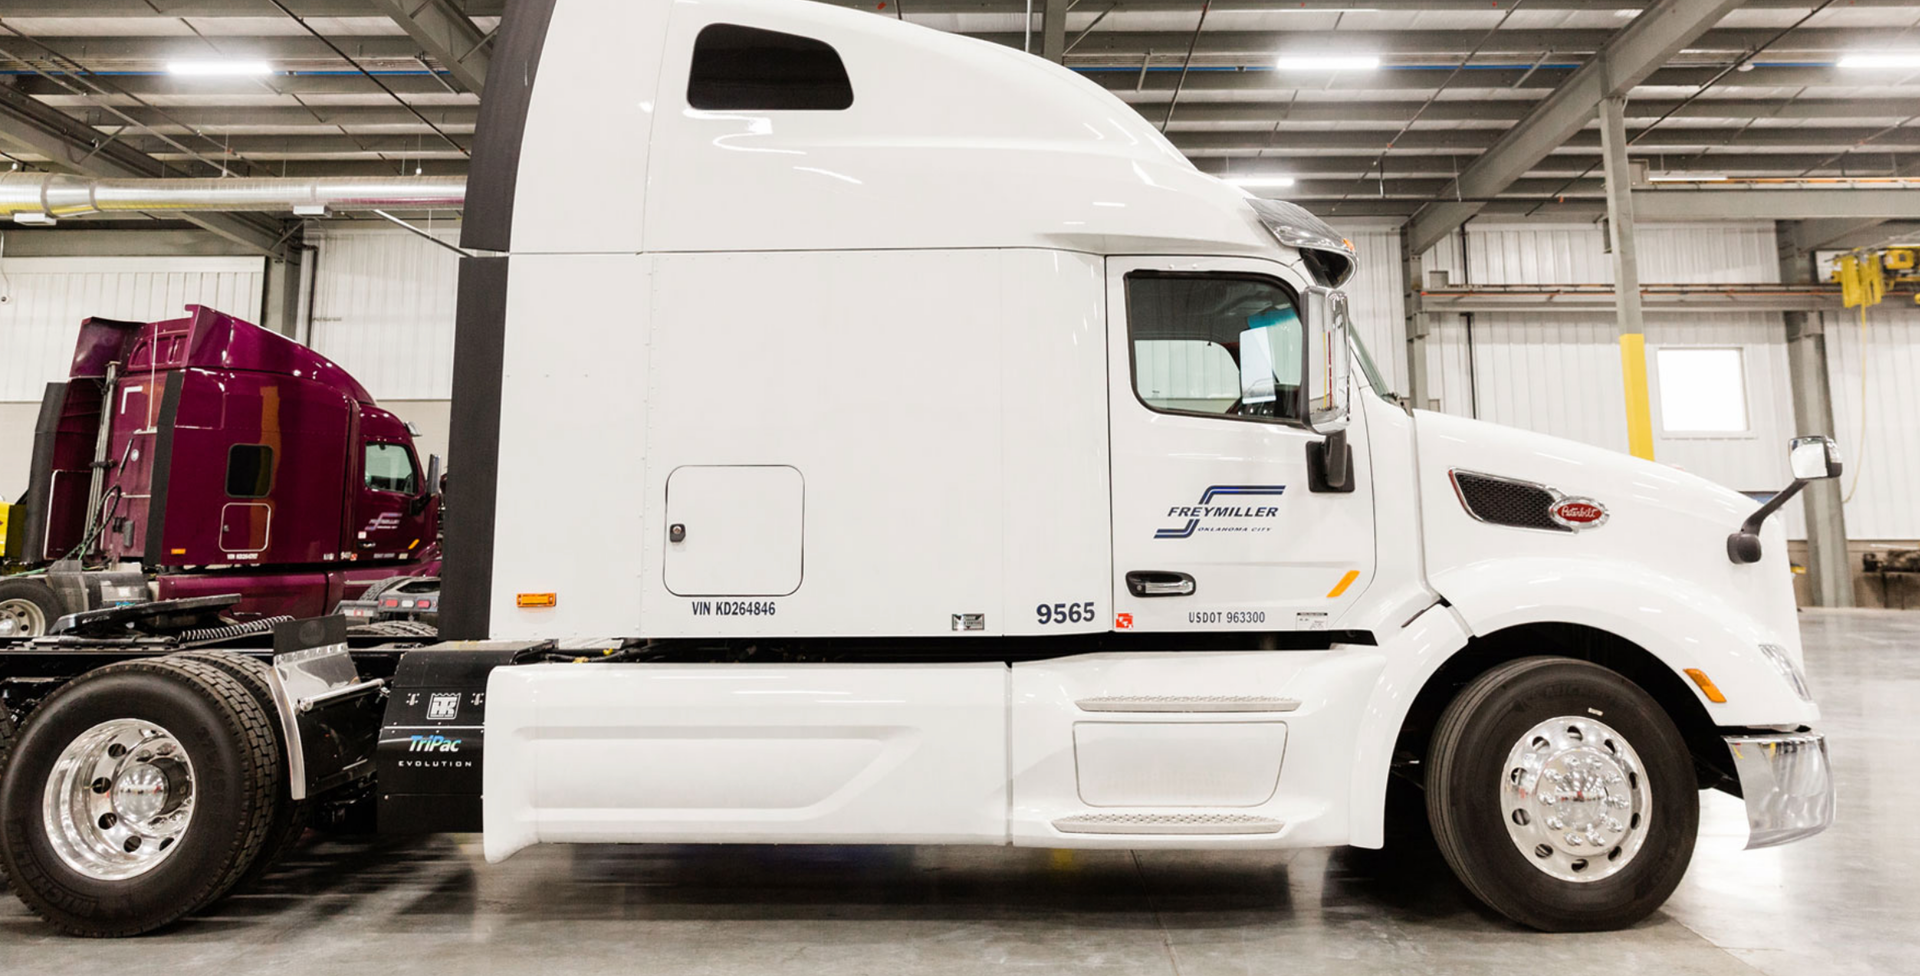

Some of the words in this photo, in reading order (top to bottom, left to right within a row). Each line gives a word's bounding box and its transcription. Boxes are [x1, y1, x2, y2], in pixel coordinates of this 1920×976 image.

[1168, 507, 1278, 517] FREYMILLER
[692, 601, 711, 616] VIN
[715, 601, 776, 616] KD264846
[1036, 602, 1096, 625] 9565
[1188, 611, 1223, 624] USDOT
[1226, 611, 1266, 624] 963300
[409, 735, 462, 752] TriPac
